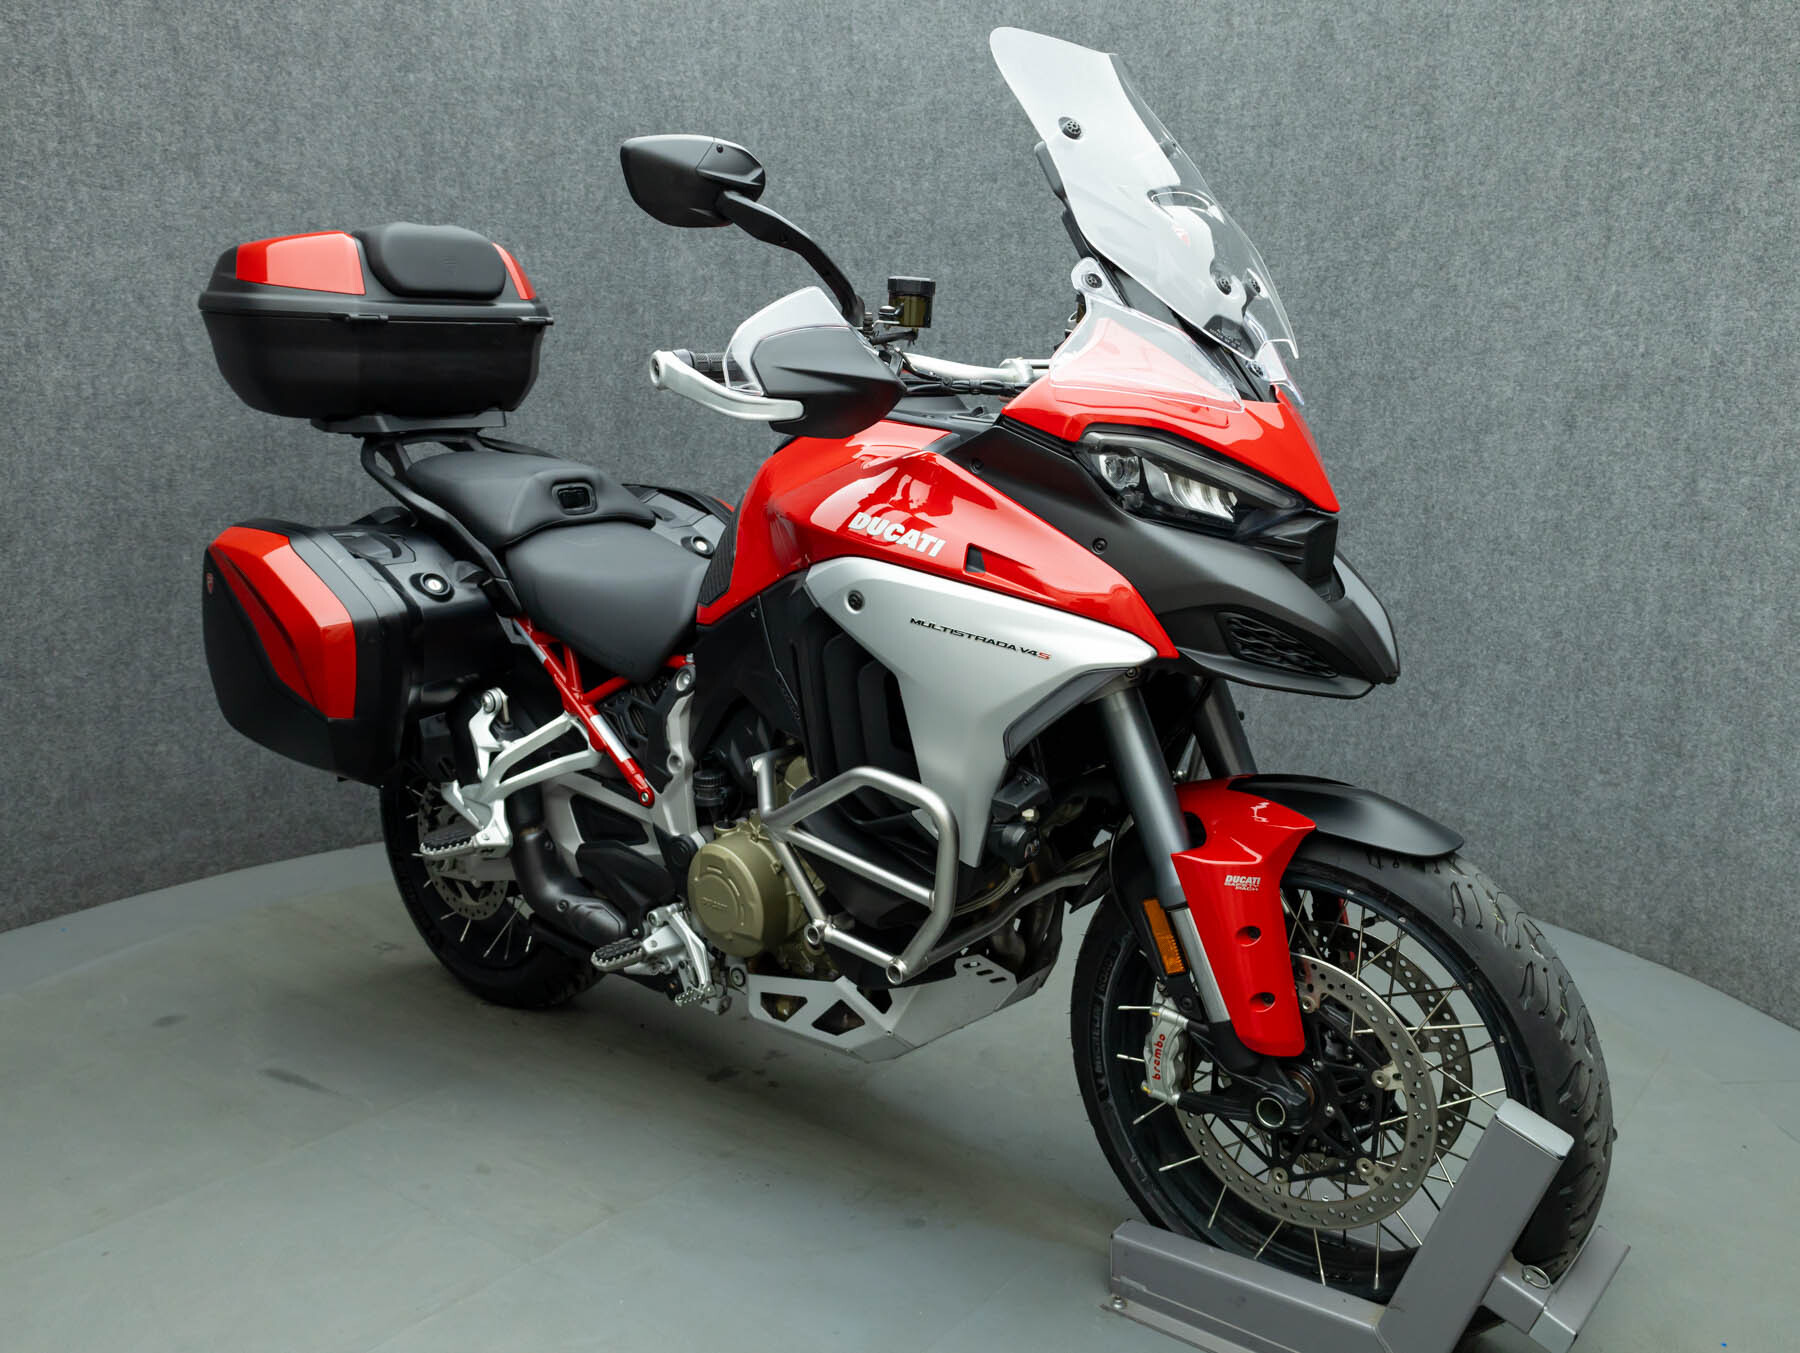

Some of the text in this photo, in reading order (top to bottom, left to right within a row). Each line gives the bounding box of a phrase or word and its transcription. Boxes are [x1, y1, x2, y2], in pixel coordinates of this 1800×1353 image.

[848, 511, 946, 557] DUCATI
[910, 618, 1051, 660] MULTISTRADA V4S
[1225, 874, 1261, 885] DUCATI
[1152, 1034, 1165, 1080] brembo
